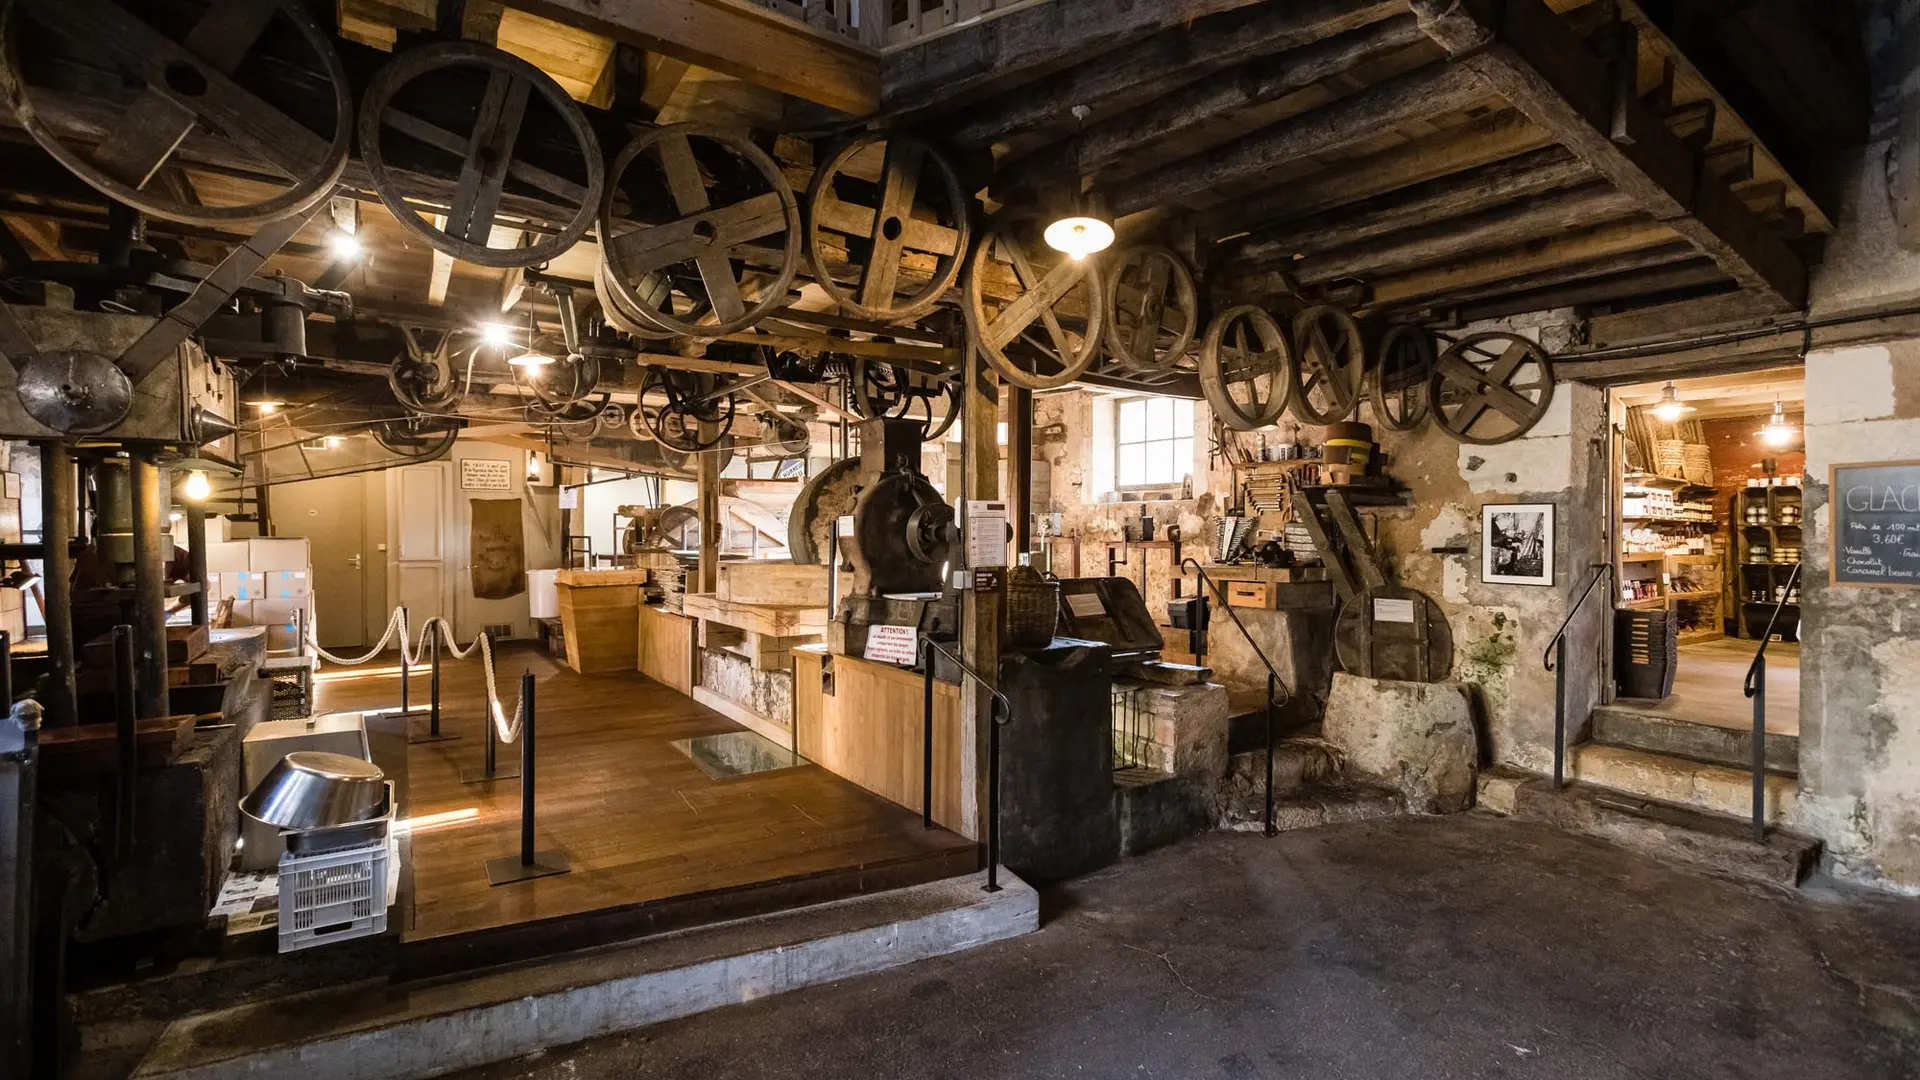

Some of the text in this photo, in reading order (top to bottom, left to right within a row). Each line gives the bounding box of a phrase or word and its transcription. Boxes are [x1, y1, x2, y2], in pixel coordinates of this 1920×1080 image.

[1846, 484, 1920, 512] GLAC
[1886, 523, 1906, 531] 100
[1846, 557, 1882, 565] Chocolat
[1846, 565, 1886, 576] Caramel
